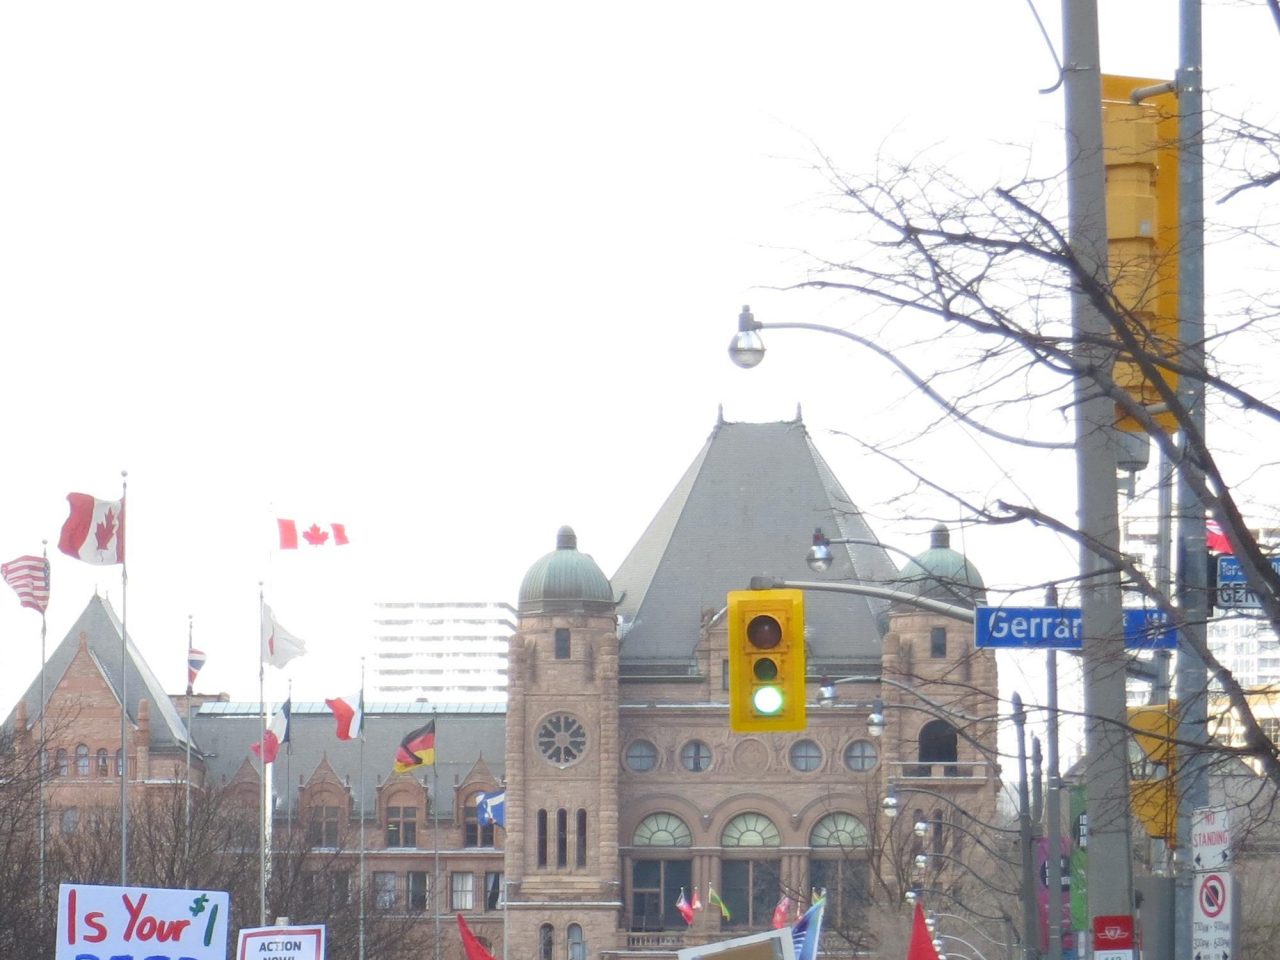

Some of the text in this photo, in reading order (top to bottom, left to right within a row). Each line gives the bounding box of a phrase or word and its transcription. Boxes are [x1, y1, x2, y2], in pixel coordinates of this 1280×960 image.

[988, 611, 1082, 638] Gerrar
[1193, 831, 1228, 848] STANDING
[67, 888, 108, 945] Is
[121, 892, 191, 943] Your
[259, 941, 302, 952] ACTION
